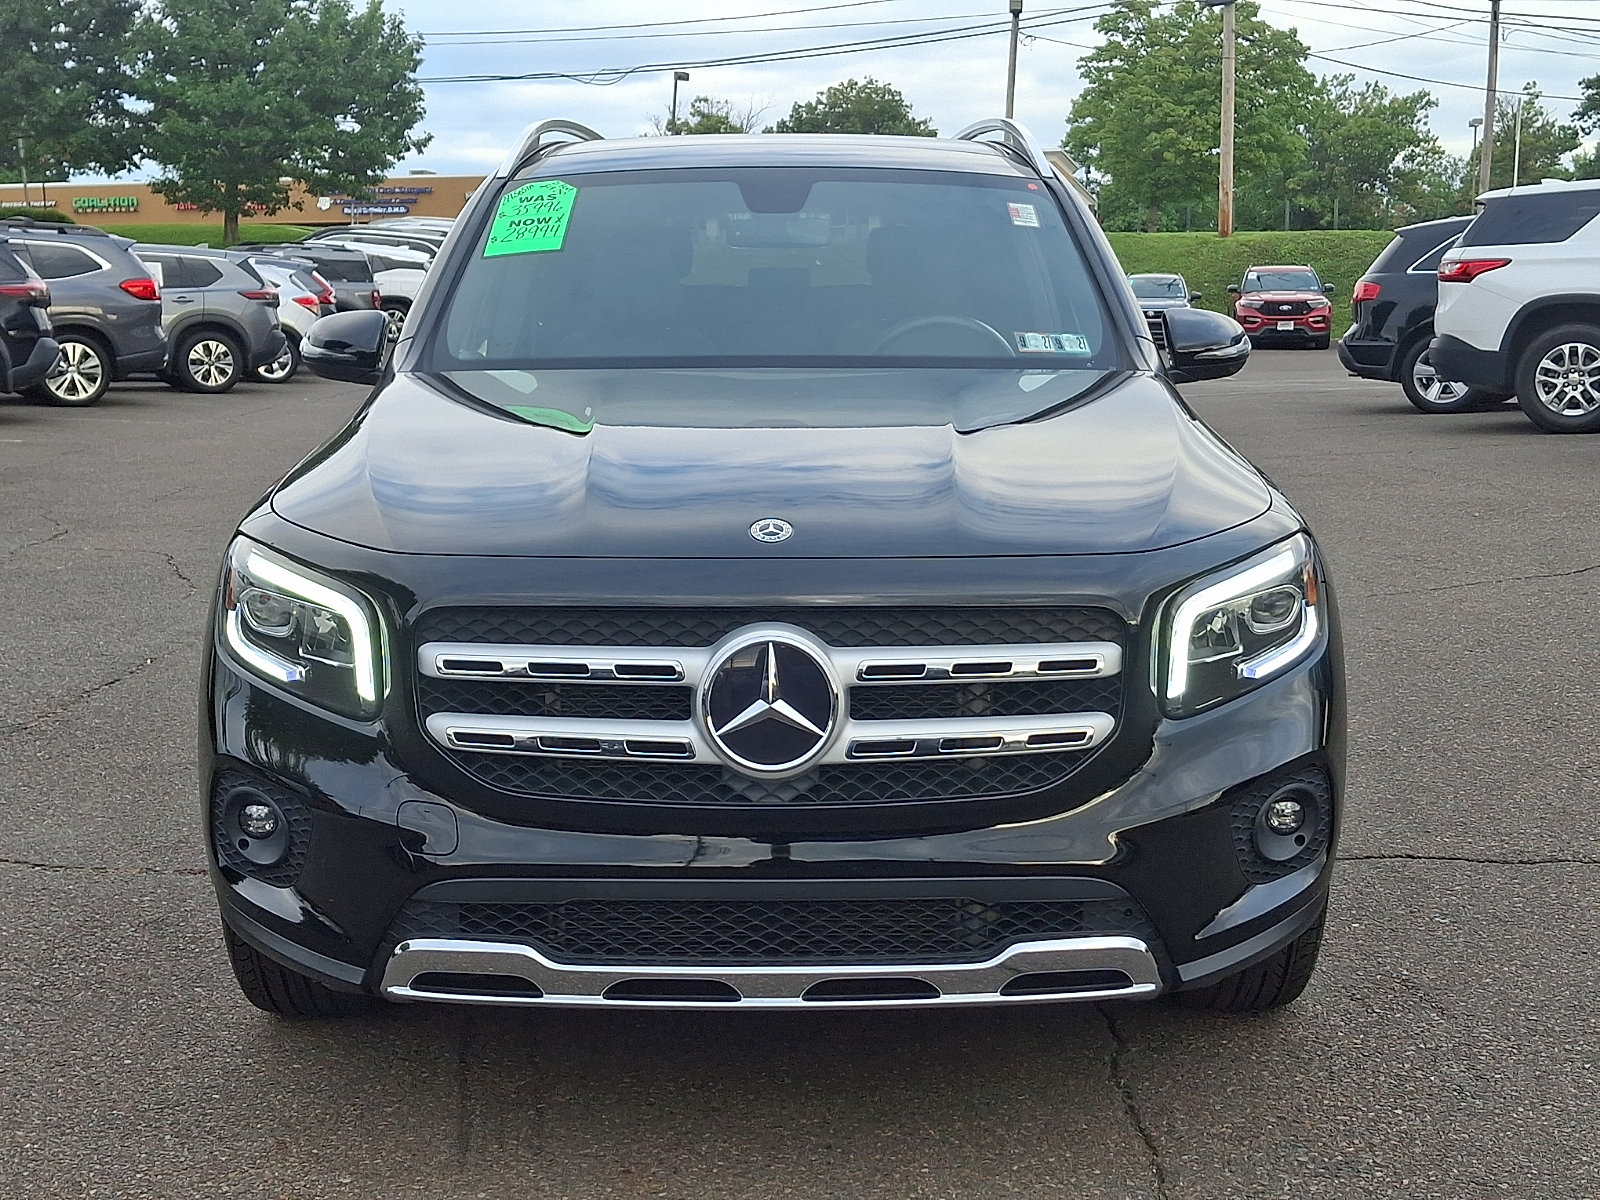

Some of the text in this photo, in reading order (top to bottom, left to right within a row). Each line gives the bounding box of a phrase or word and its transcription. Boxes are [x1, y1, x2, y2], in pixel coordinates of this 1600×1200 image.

[72, 196, 138, 207] COALITION
[519, 194, 557, 203] WAS
[509, 217, 552, 227] NOW
